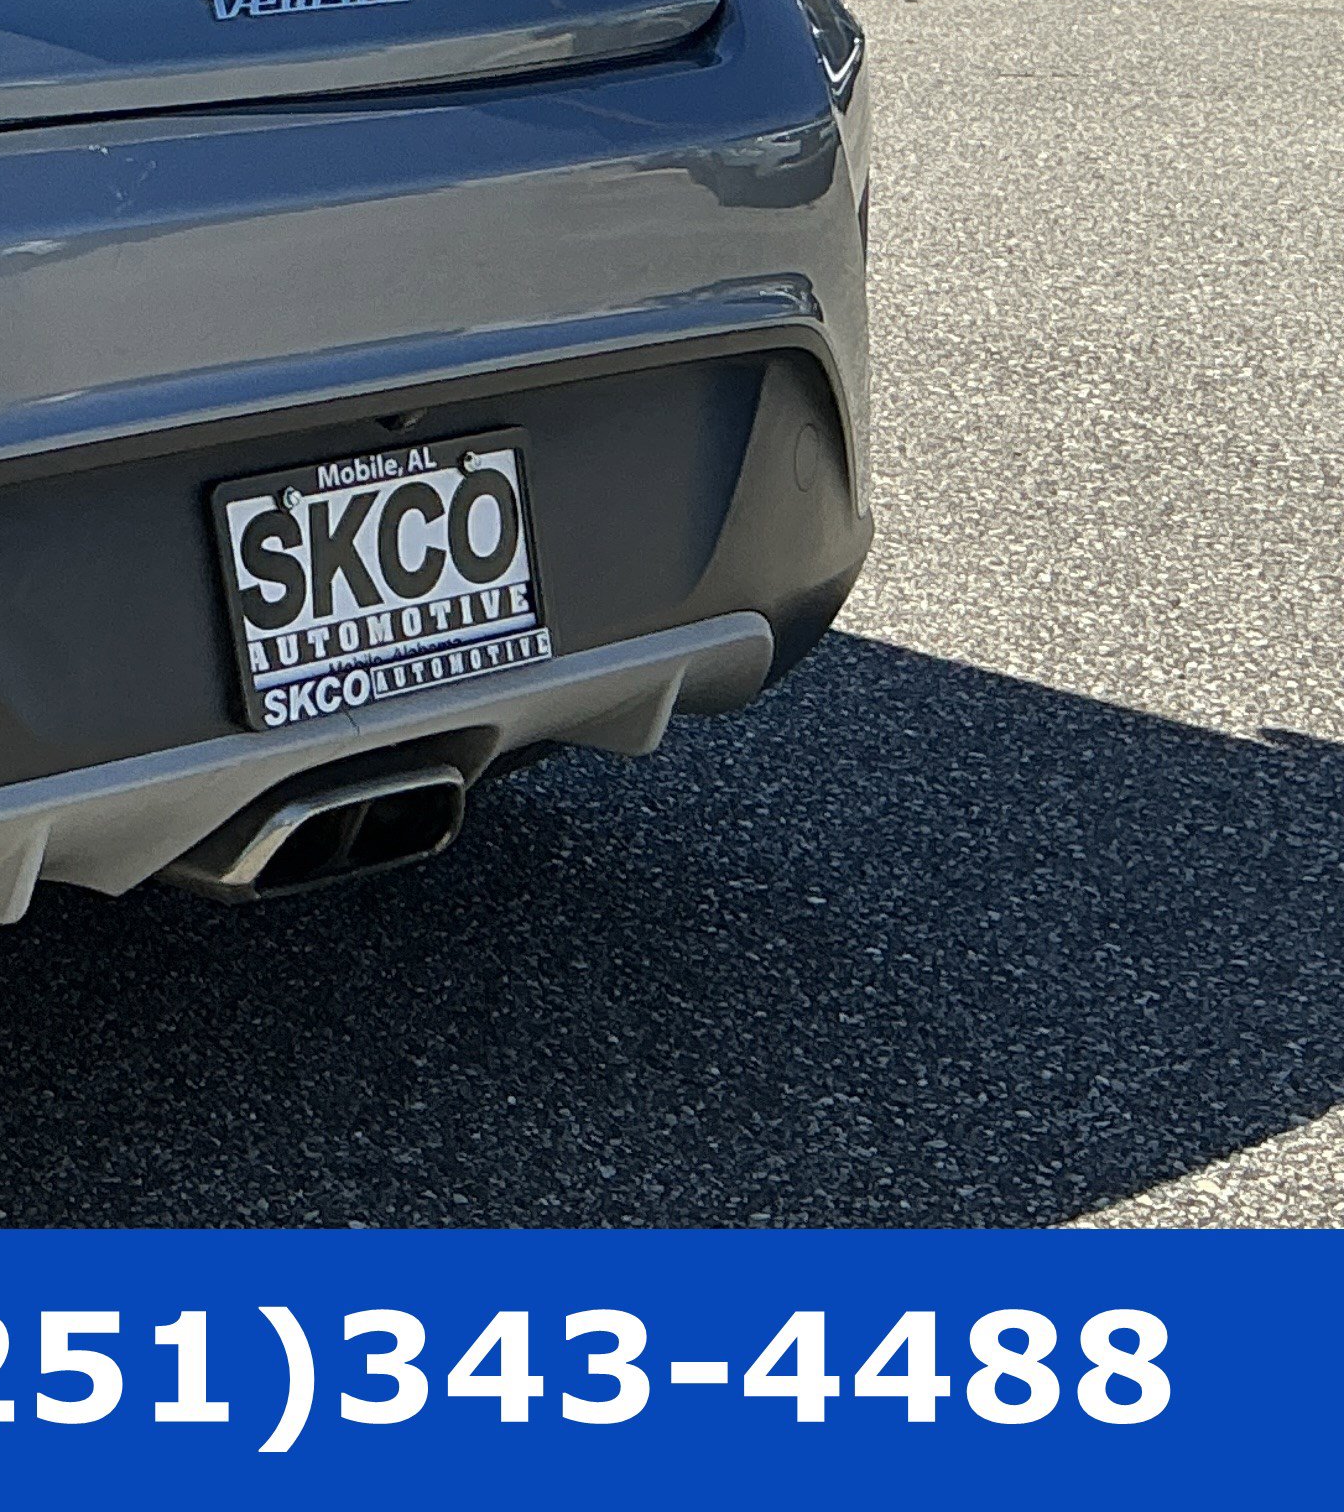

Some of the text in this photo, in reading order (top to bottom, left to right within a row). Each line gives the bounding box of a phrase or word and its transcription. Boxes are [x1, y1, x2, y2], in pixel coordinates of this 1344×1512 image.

[317, 446, 438, 489] Mobile, AL
[239, 468, 519, 630] SKCO
[248, 585, 530, 673] AUTOMOTIVE
[374, 632, 550, 694] AUTOMOTIVE
[264, 668, 370, 726] SKCO
